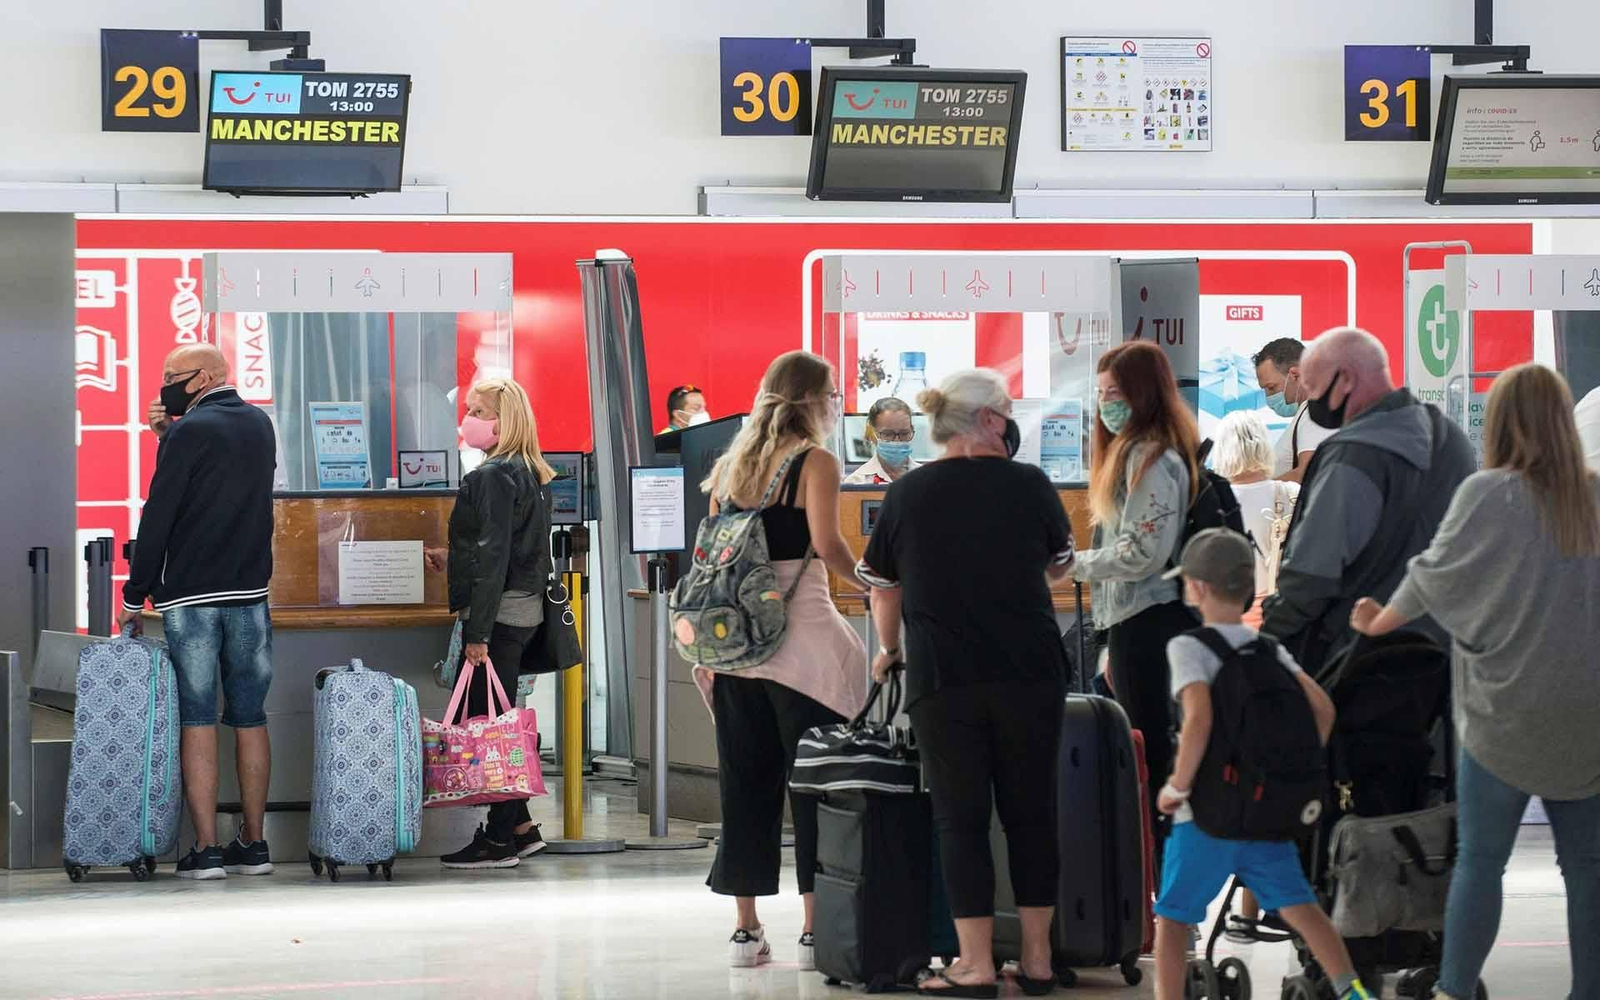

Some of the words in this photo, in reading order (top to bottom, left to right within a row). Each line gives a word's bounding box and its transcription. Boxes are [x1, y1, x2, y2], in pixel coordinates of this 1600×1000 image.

[113, 66, 187, 118] 29
[265, 93, 291, 103] TUI
[305, 81, 348, 98] TOM
[353, 82, 399, 99] 2755
[732, 72, 800, 122] 30
[921, 88, 961, 104] TOM
[965, 88, 1008, 104] 2755
[329, 101, 374, 112] 13:00
[882, 98, 908, 110] TUI
[942, 106, 984, 117] 13:00
[1359, 79, 1417, 127] 31
[211, 119, 400, 143] MANCHESTER
[831, 123, 1007, 147] MANCHESTER
[1229, 308, 1260, 319] GIFTS
[1153, 318, 1184, 345] TUI
[426, 465, 441, 473] TUI
